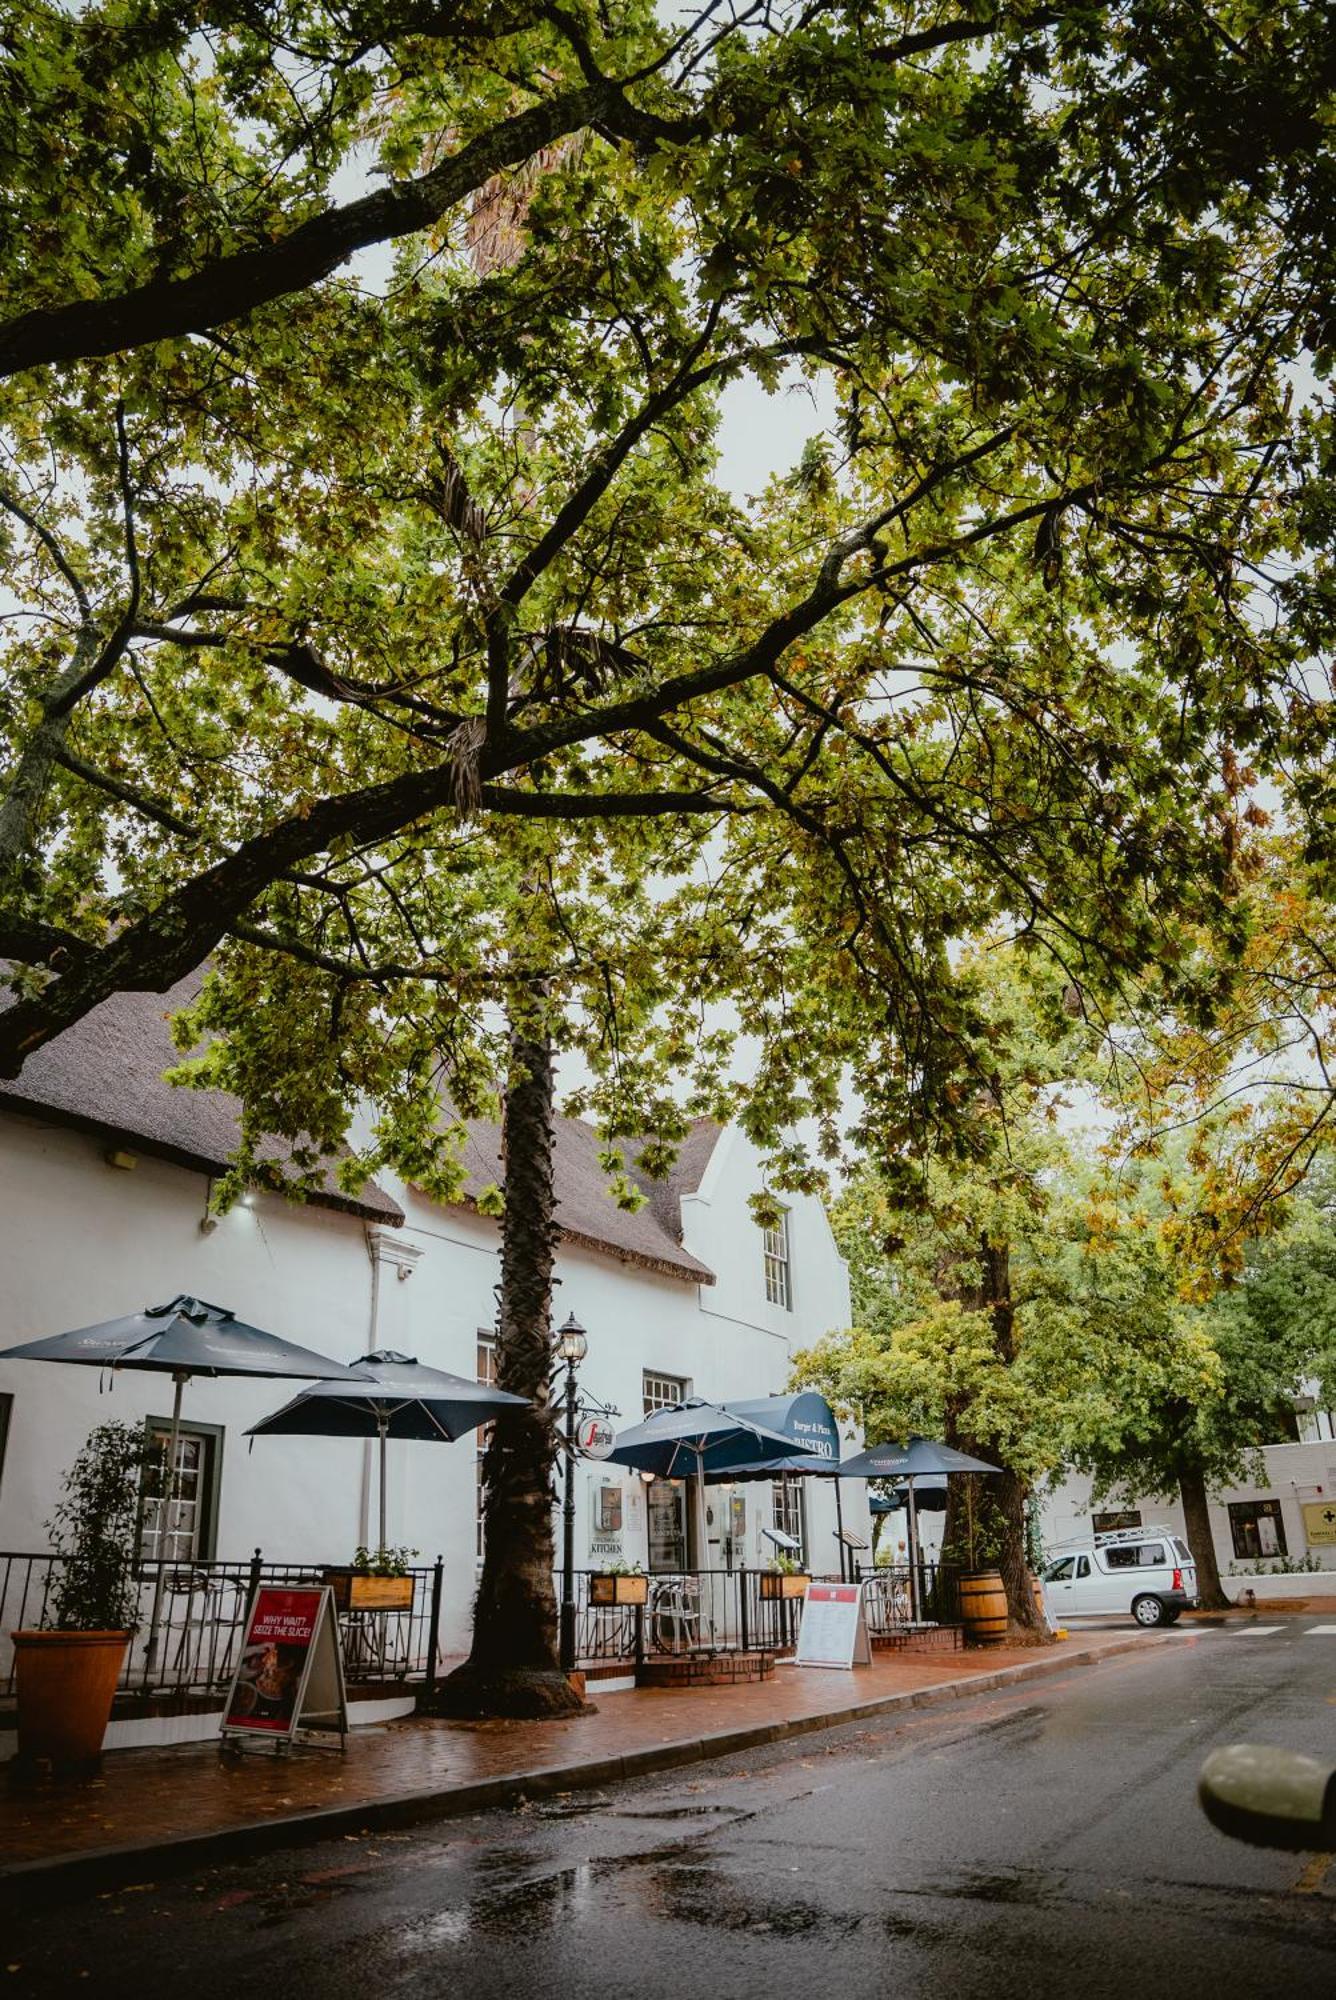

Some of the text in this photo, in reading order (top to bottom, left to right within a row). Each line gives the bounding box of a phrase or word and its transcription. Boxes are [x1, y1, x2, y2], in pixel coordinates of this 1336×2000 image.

[793, 1420, 811, 1433] Burger
[591, 1543, 622, 1554] KITCHEN
[263, 1615, 306, 1626] WHY WAIT?
[253, 1625, 272, 1635] SEIZE
[274, 1626, 287, 1636] THE
